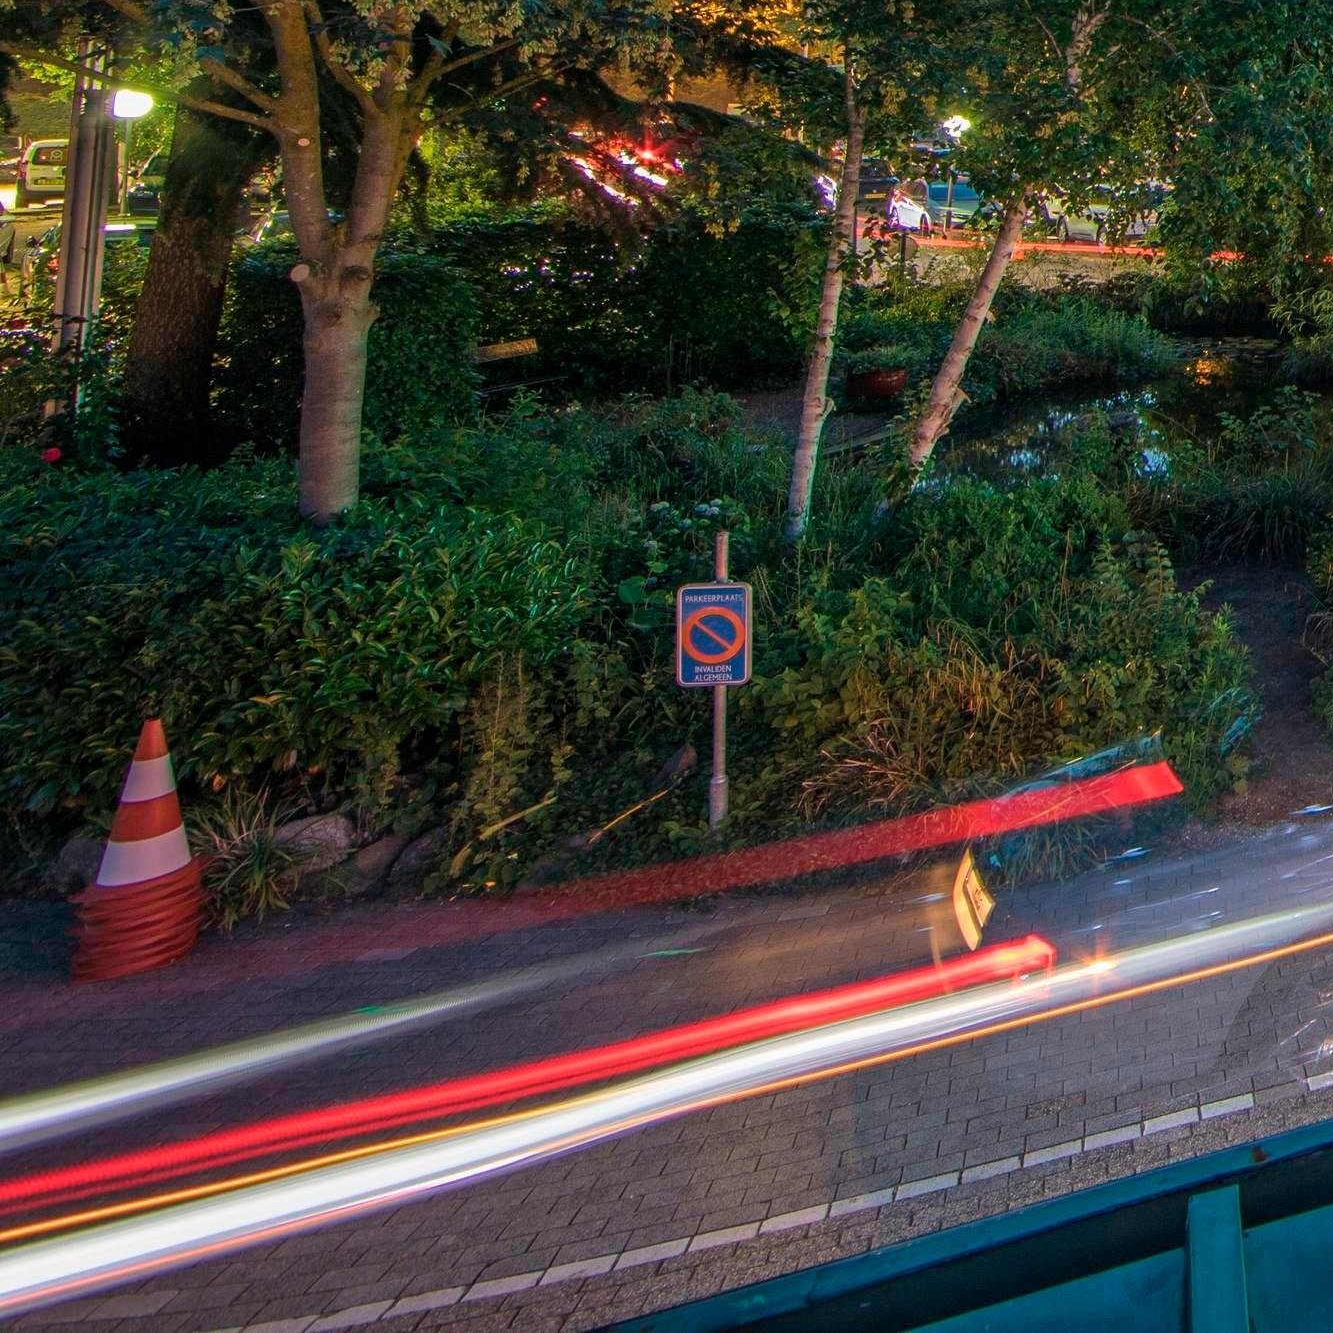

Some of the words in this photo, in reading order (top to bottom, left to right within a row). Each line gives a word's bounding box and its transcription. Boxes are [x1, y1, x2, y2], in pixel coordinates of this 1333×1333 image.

[684, 593, 744, 603] PARKEERPLAATS
[694, 665, 732, 673] INVALIDEN
[694, 673, 733, 682] ALGEMEEN
